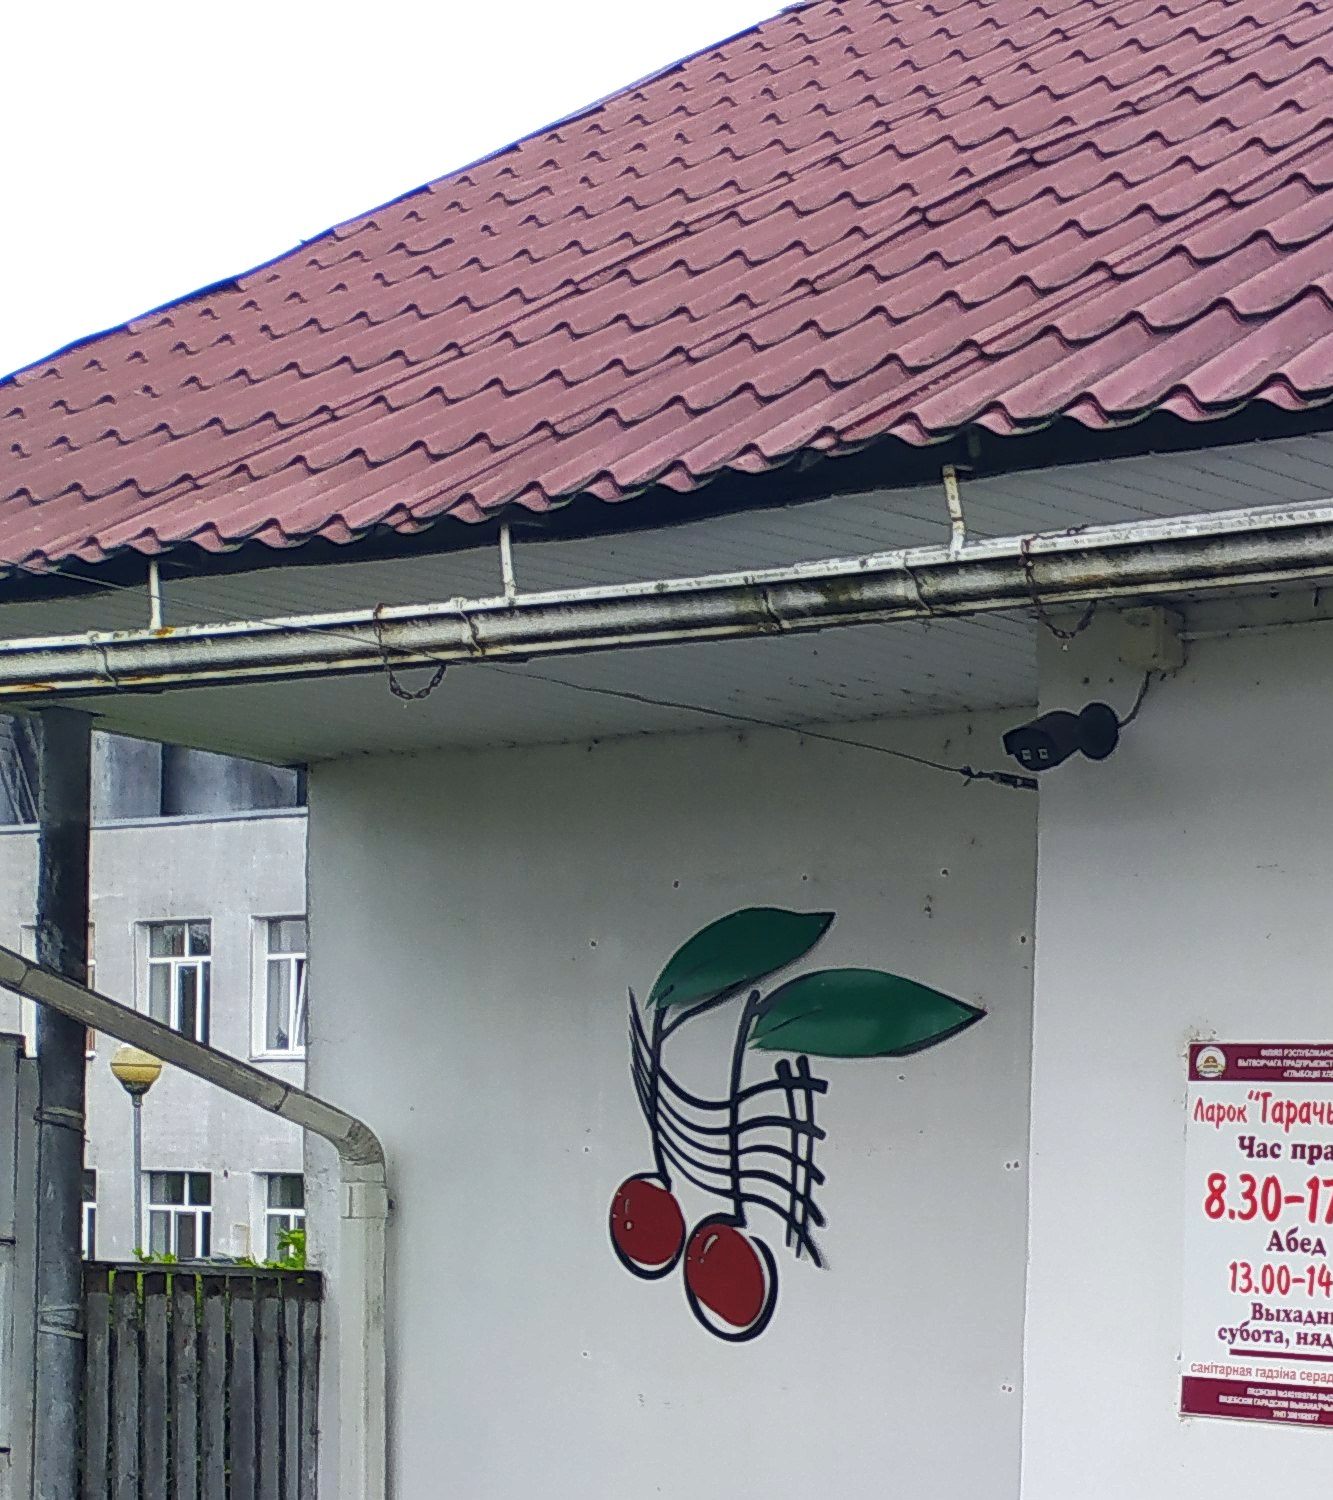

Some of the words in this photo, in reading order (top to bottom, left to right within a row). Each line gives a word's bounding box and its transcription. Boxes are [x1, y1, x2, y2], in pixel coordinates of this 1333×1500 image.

[1194, 1097, 1247, 1129] Ларок
[1238, 1136, 1282, 1159] Час
[1266, 1227, 1327, 1256] Абед
[1217, 1321, 1290, 1348] субота,
[1190, 1363, 1252, 1379] санітарная
[1255, 1367, 1297, 1381] гадзіна
